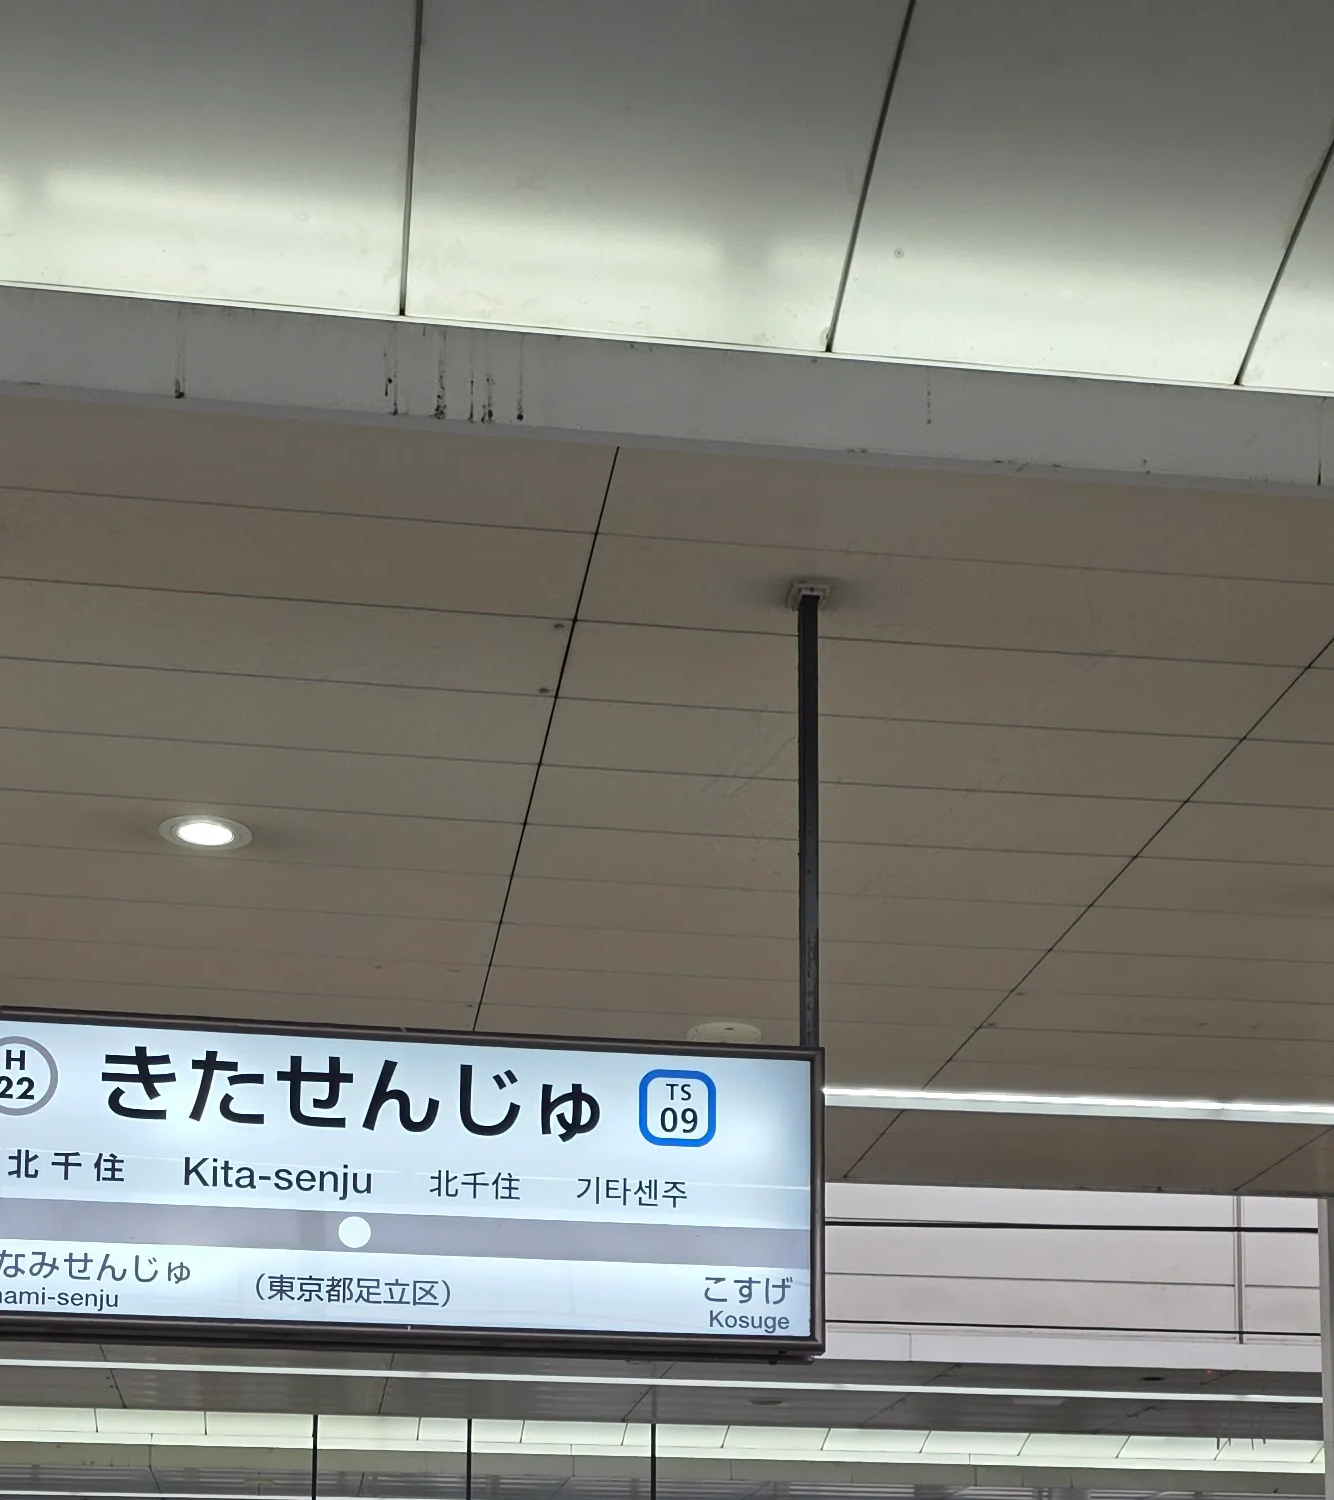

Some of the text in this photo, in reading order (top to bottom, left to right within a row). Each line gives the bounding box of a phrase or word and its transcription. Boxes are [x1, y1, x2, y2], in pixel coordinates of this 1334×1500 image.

[5, 1049, 26, 1070] H
[101, 1046, 600, 1142] きたせんじゅ
[666, 1083, 692, 1101] TS
[660, 1108, 698, 1133] 09
[8, 1149, 124, 1182] 北千住
[184, 1156, 372, 1200] Kita-senju
[429, 1170, 521, 1200] 北千住
[576, 1176, 688, 1208] 기타센주
[704, 1276, 793, 1304] こすげ
[709, 1310, 790, 1333] Kosuge
